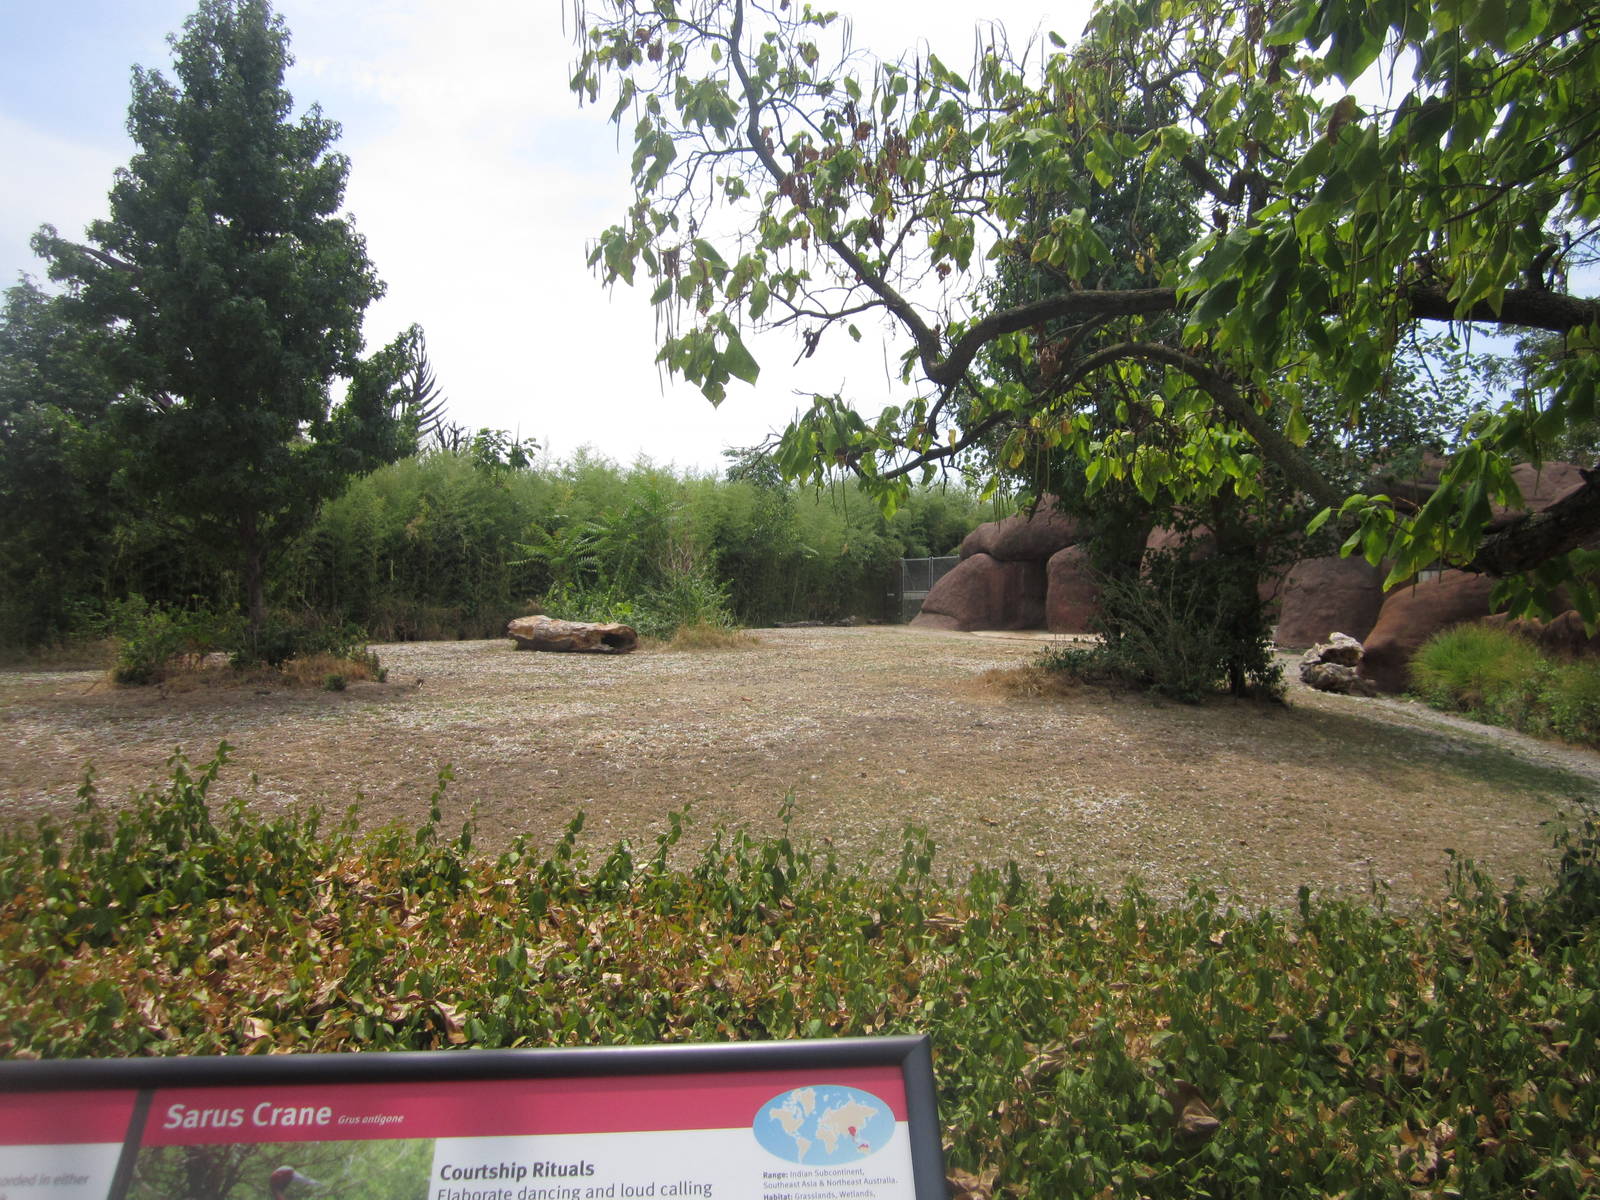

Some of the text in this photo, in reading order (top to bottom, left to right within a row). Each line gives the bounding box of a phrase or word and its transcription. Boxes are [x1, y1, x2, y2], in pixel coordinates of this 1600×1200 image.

[164, 1102, 332, 1129] Sarus Crane
[338, 1114, 404, 1125] Grus antigone
[440, 1160, 595, 1182] Courtship Rituals
[763, 1168, 865, 1179] Range: Indian Subcontinent,
[763, 1181, 800, 1189] Southeast
[827, 1178, 862, 1187] Northeast
[863, 1177, 899, 1185] Australia.
[437, 1181, 713, 1200] Elaborate dancing and loud calling
[794, 1191, 838, 1199] Grasslands,
[840, 1189, 876, 1198] Wetlands,
